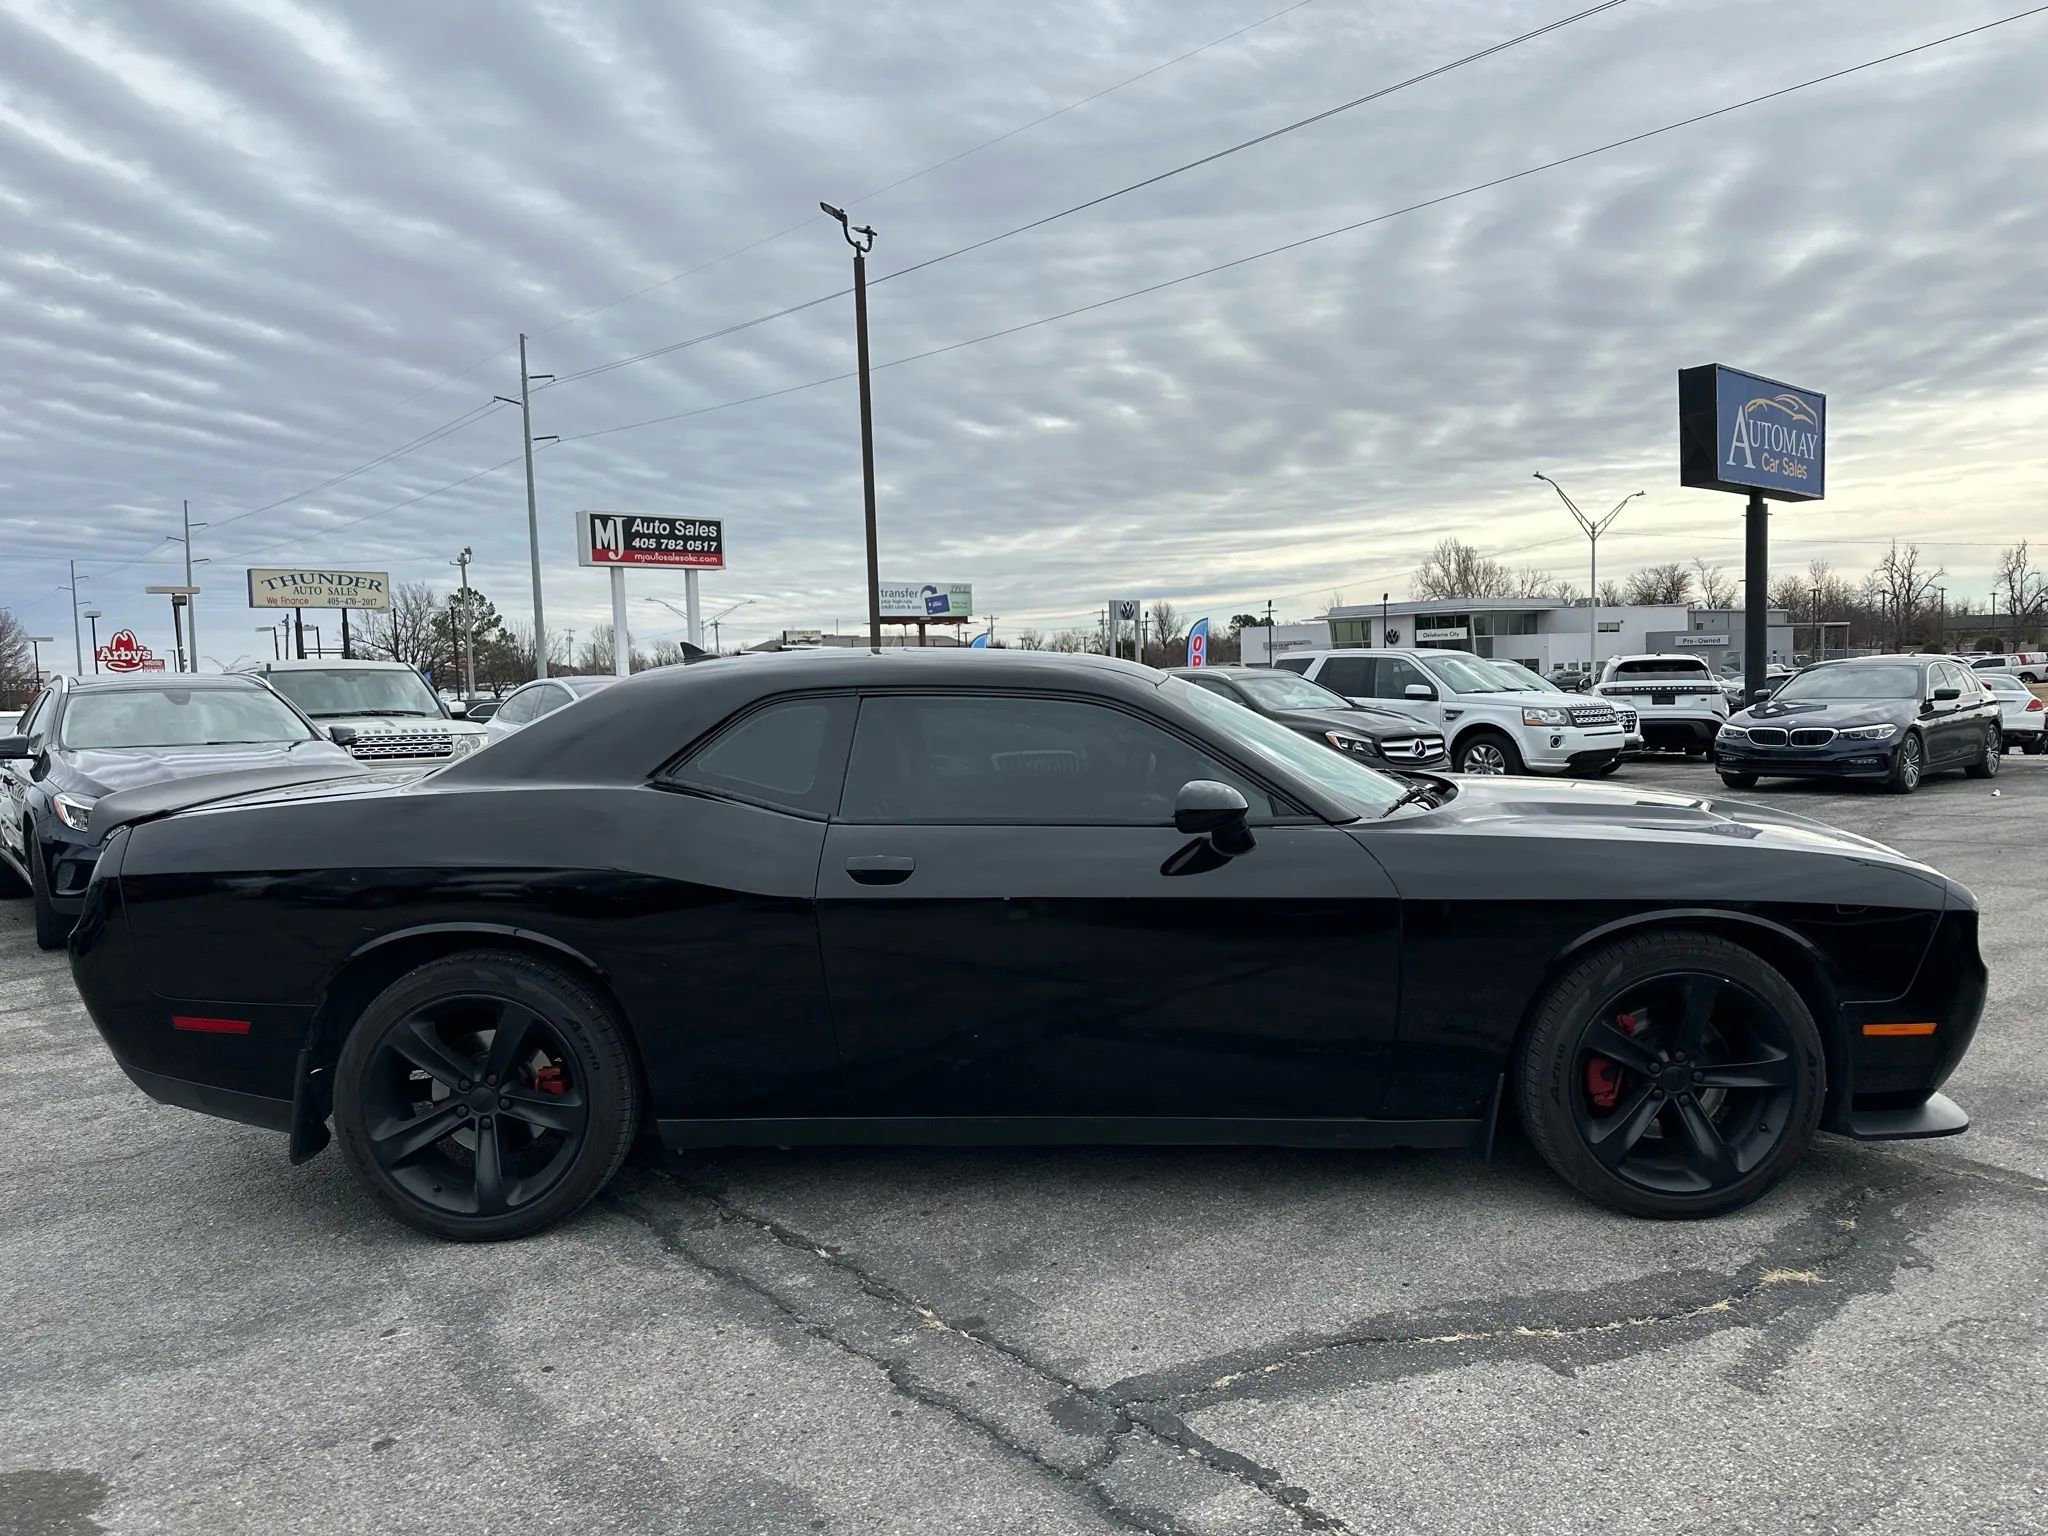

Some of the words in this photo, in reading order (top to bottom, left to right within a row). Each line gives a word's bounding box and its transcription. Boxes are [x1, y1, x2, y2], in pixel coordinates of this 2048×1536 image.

[1726, 404, 1818, 469] AUTOMAY
[1761, 452, 1780, 474] Car
[1782, 457, 1808, 480] Sales
[631, 518, 670, 536] Auto
[674, 520, 718, 538] Sales
[594, 516, 628, 561] MJ
[631, 537, 657, 549] 405
[660, 539, 684, 551] 782
[686, 540, 718, 552] 0517
[634, 552, 718, 564] mjautosalesokc.com
[261, 572, 383, 593] THUNDER
[293, 586, 322, 596] AUTO
[327, 587, 359, 597] SALES
[880, 587, 919, 598] transfer
[266, 596, 278, 605] We
[280, 596, 310, 606] Finance
[327, 597, 377, 606] 405-470-2017
[1682, 637, 1721, 645] Pre-Owned
[99, 646, 152, 664] Arby's
